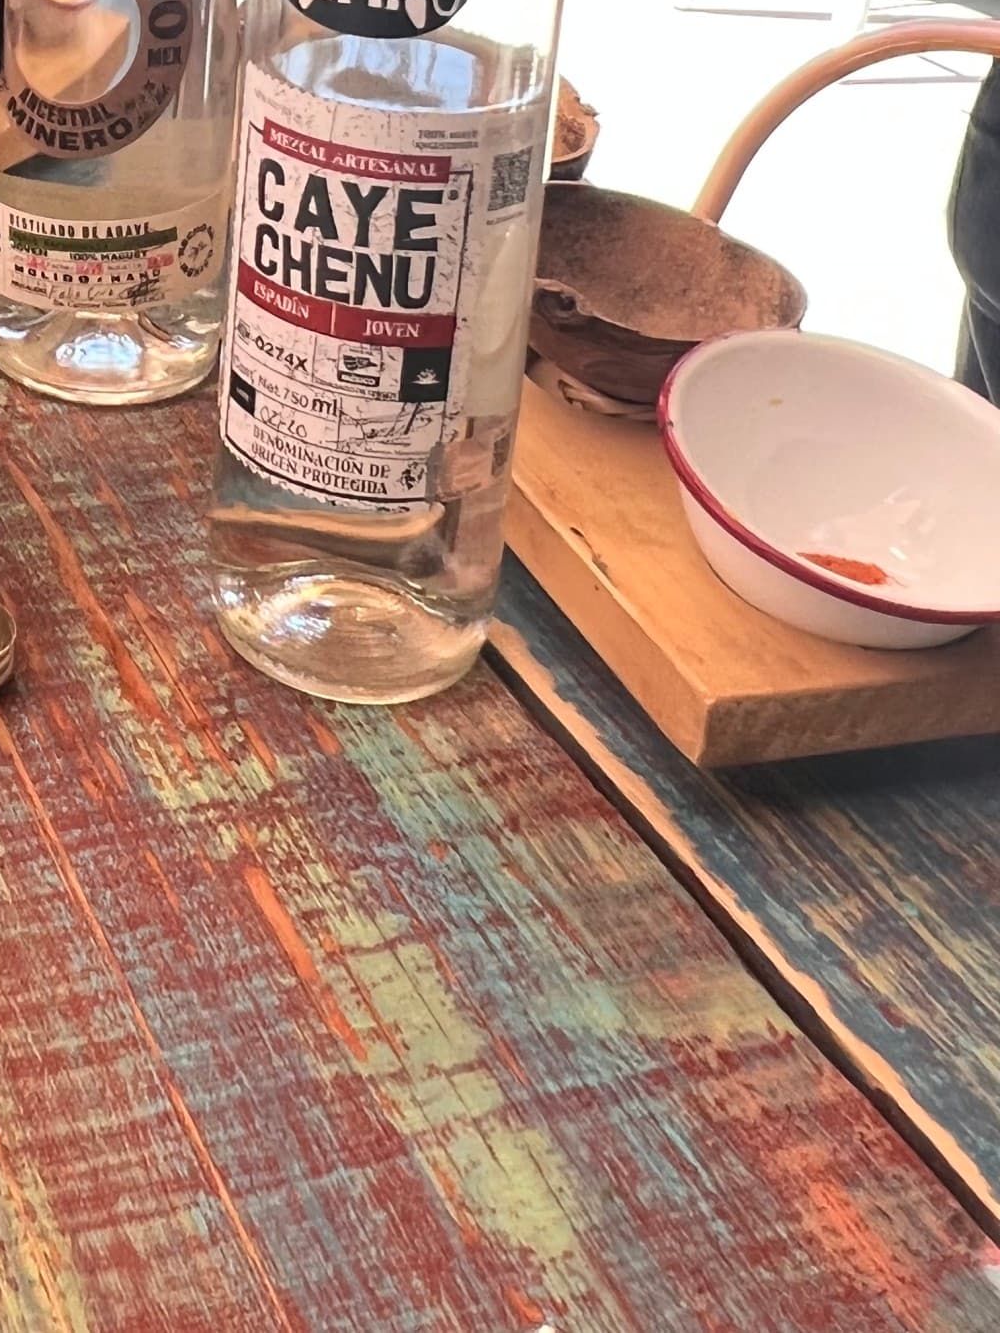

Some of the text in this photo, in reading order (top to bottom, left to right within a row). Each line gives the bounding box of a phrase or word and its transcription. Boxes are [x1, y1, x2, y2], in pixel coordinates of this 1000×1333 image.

[7, 96, 133, 151] MINERO
[18, 87, 114, 127] ANCESTRAL
[269, 128, 438, 177] MEZCAL ARTESANAL
[9, 213, 151, 239] DESTILADO DE AGAVE
[258, 158, 445, 252] CAYE
[253, 223, 437, 310] CHENU
[253, 281, 421, 338] ESPADÍN JOVEN
[251, 443, 388, 495] ORIGEN PROTEGIDA
[253, 424, 391, 478] DENOMINACIÓN DE
